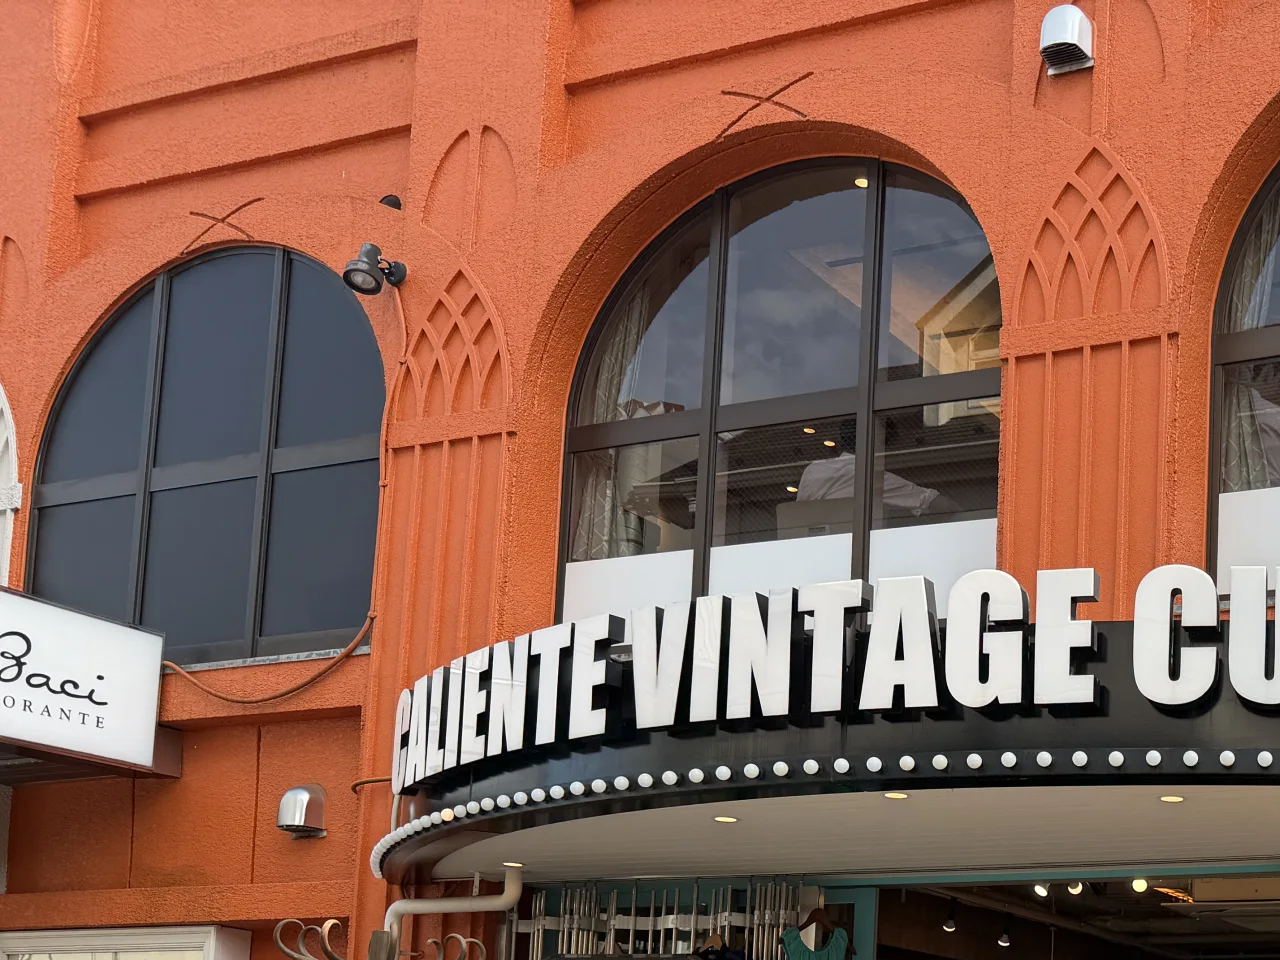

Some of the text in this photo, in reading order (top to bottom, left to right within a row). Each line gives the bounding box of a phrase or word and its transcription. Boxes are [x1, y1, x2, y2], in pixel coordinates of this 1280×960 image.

[3, 695, 106, 729] ORANTE
[392, 612, 617, 796] CALIENTE
[630, 567, 1097, 729] VINTAGE
